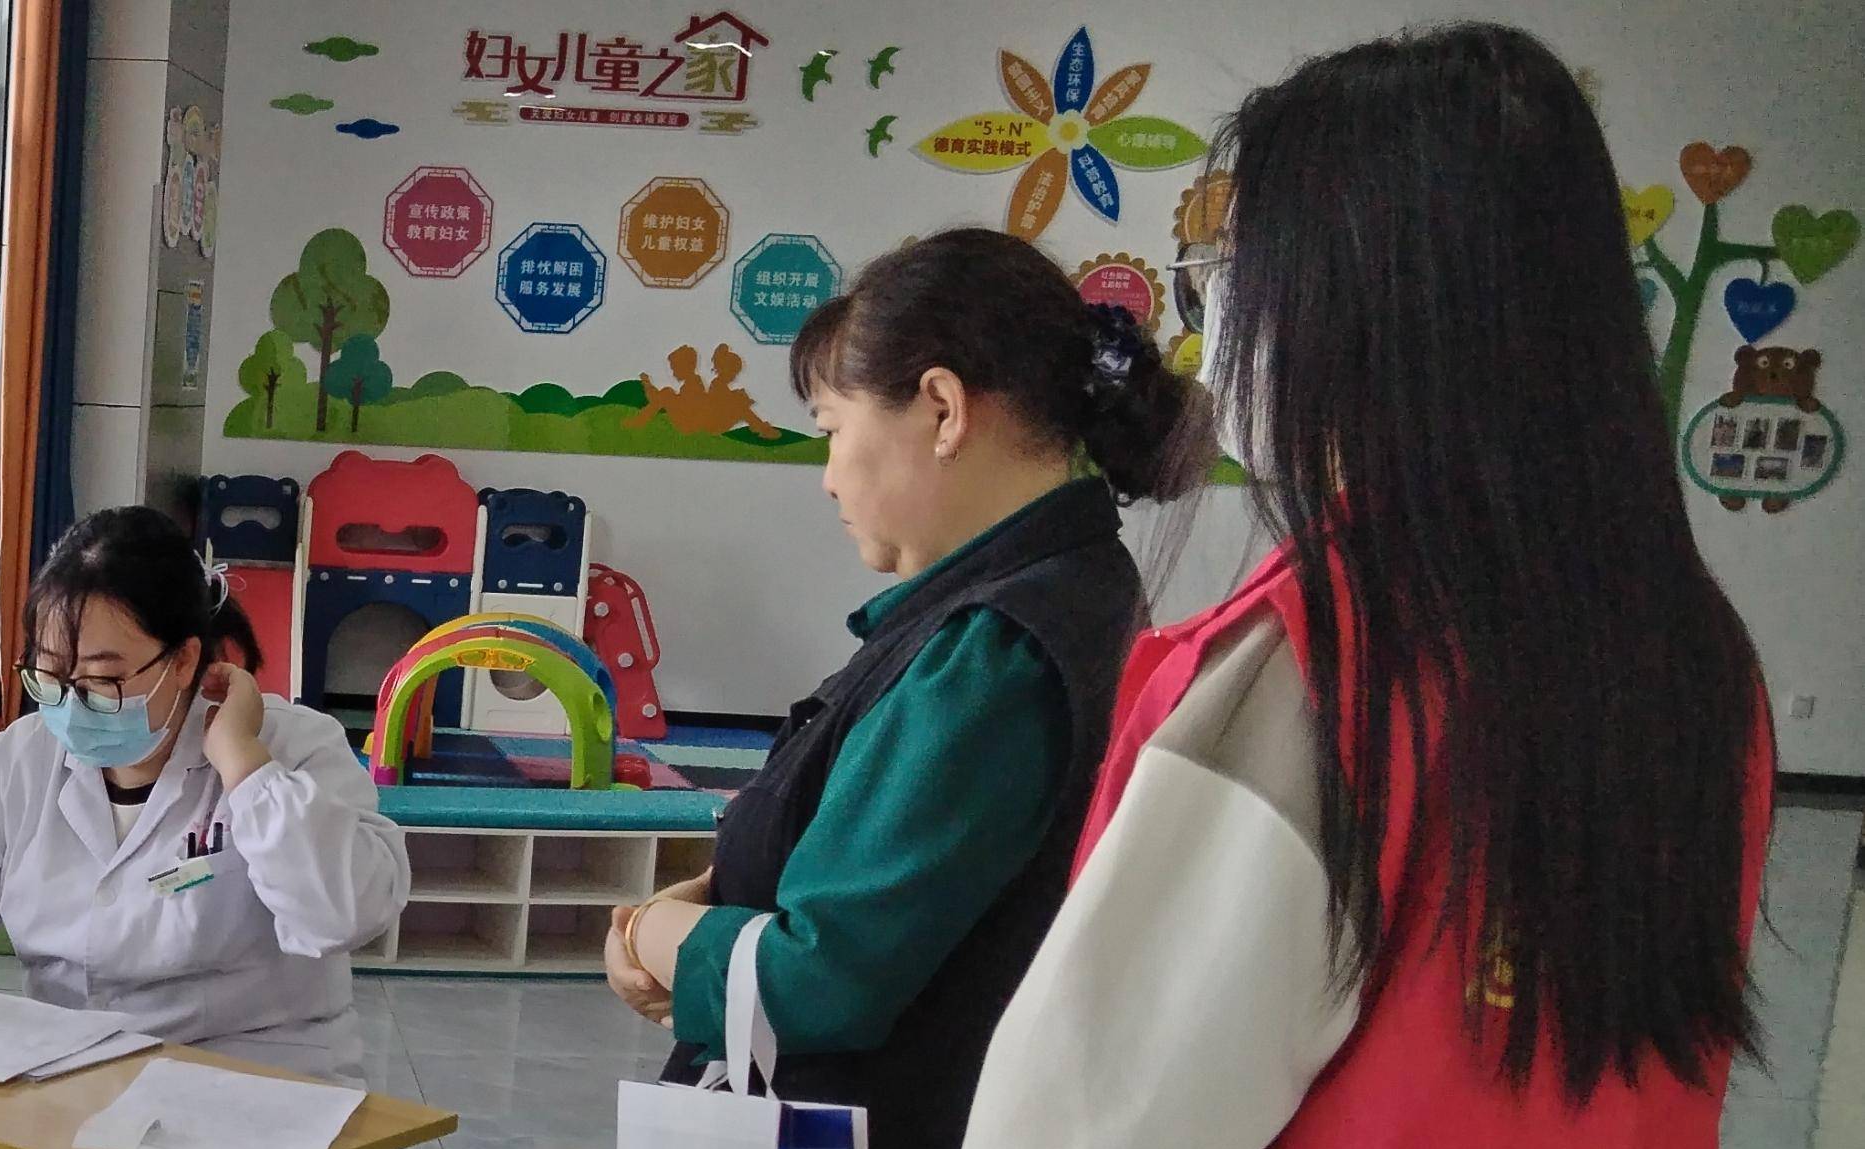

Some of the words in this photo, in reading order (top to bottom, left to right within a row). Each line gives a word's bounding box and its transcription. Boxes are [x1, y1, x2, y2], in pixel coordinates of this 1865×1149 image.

[464, 11, 770, 101] 妇女儿童之家
[1065, 42, 1085, 102] 生态环保
[934, 136, 1032, 157] 德育实践模式
[408, 203, 471, 221] 宣传政策
[642, 213, 707, 232] 维护妇女
[406, 224, 470, 241] 教育妇女
[640, 235, 705, 253] 儿童权益
[520, 259, 584, 277] 排忧解困
[519, 279, 583, 298] 服务发展
[755, 271, 820, 289] 组织开展
[753, 291, 818, 309] 文娱活动
